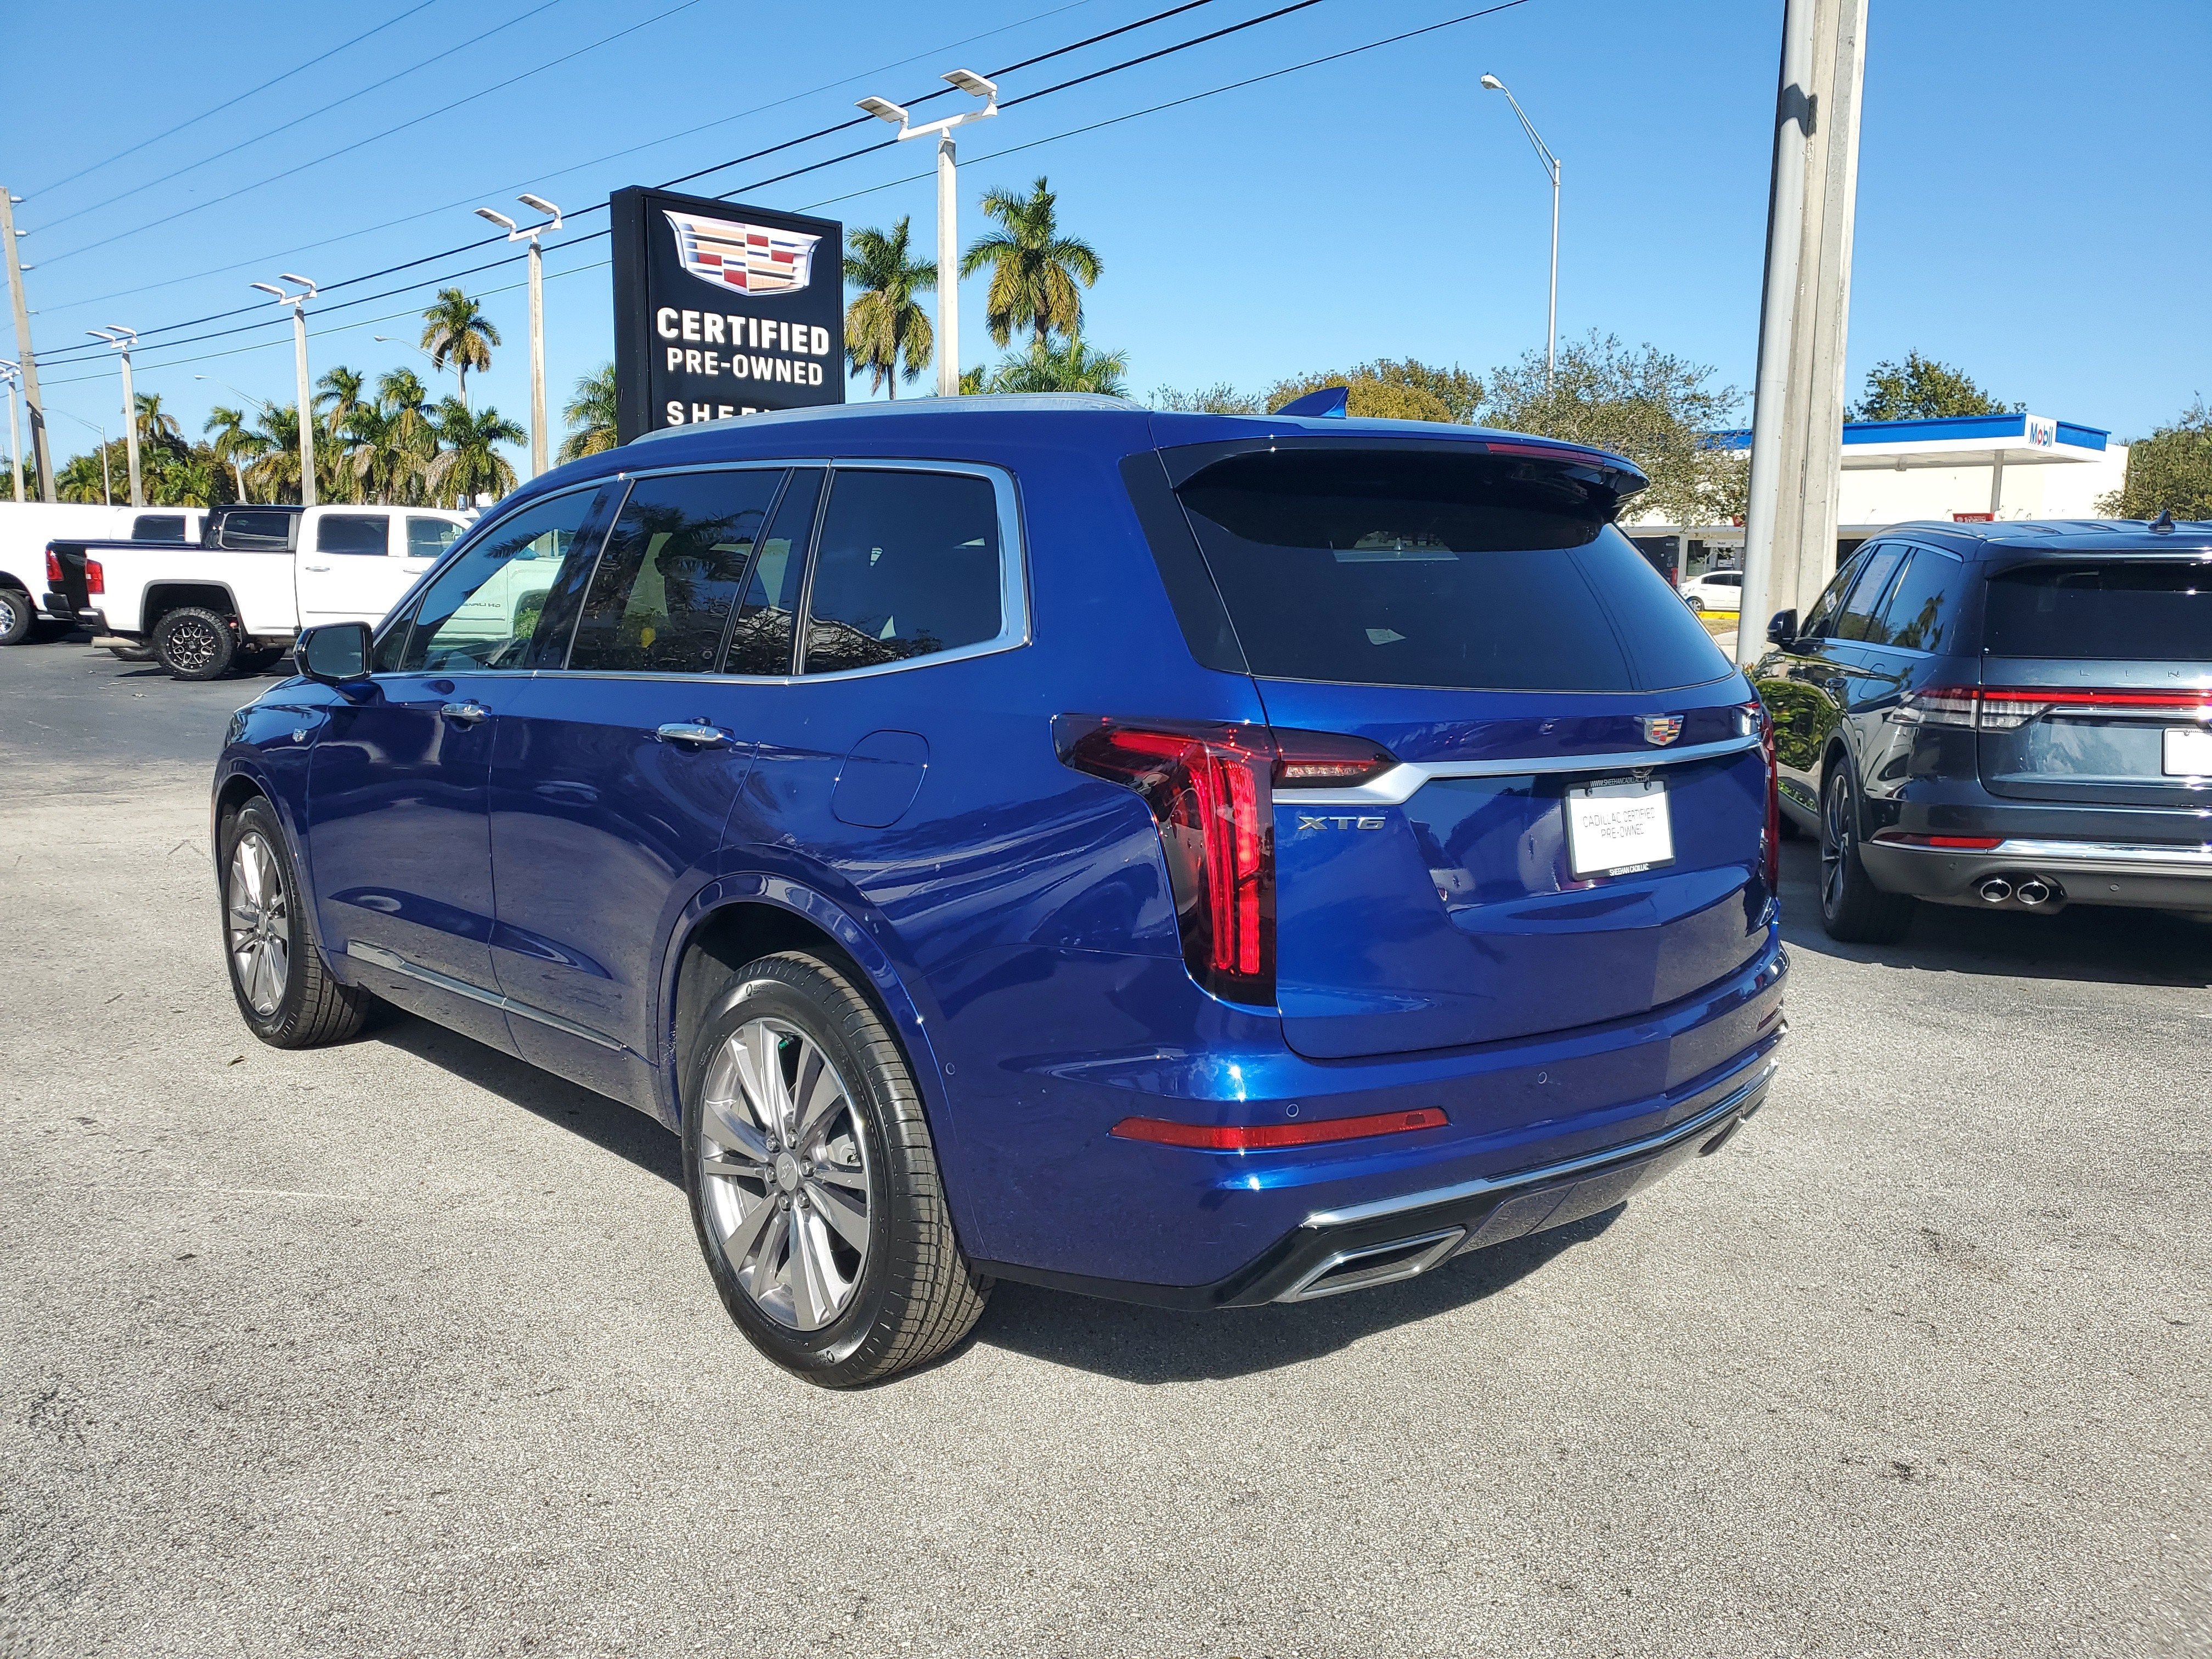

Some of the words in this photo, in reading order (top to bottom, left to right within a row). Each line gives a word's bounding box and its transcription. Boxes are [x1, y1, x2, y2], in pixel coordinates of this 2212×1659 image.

[657, 307, 829, 356] CERTIFIED
[667, 347, 823, 386] PRE-OWNED
[2029, 422, 2053, 447] Mobil
[1298, 816, 1386, 830] XT6
[1583, 812, 1621, 827] CADILLAC
[1623, 807, 1655, 822] CERTIFIED
[1601, 823, 1644, 839] PRE-OWNED
[1609, 866, 1630, 876] SHEEHAN
[1629, 863, 1649, 873] CADILLAC
